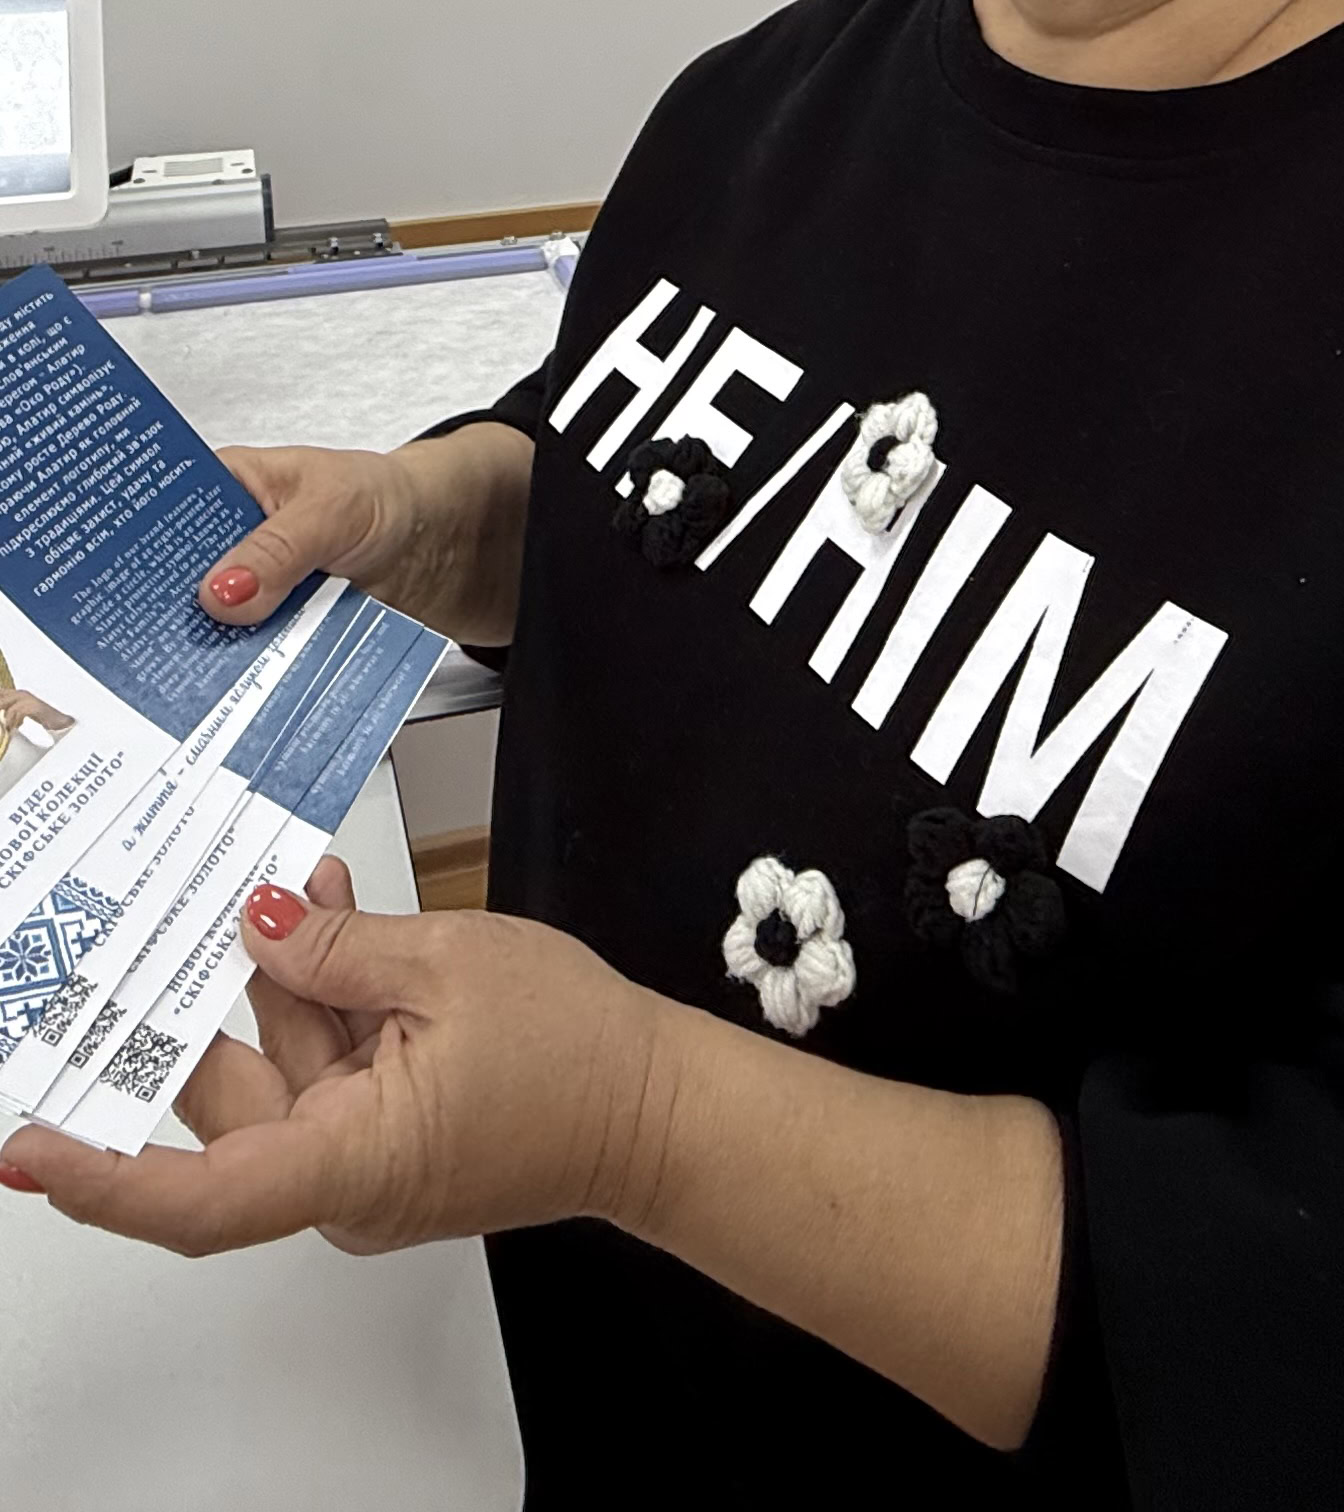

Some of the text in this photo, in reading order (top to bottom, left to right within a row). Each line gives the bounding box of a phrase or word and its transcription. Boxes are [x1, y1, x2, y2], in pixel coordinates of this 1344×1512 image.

[14, 293, 53, 320] містить
[18, 337, 46, 356] колі,
[47, 323, 62, 336] що
[15, 393, 44, 414] «Око
[43, 364, 84, 395] Роду»).
[47, 344, 85, 373] Алатир
[16, 403, 57, 435] Алатир
[58, 361, 115, 405] символізує
[24, 444, 57, 473] росте
[57, 413, 97, 448] Дерево
[96, 393, 123, 414] Роду.
[25, 416, 67, 448] «живий
[14, 428, 130, 522] елемент логотипу, ми
[37, 449, 77, 482] Алатир
[93, 397, 141, 439] головний
[0, 492, 76, 556] підкреслюємо
[77, 450, 126, 493] глибокий
[34, 460, 194, 596] гармонію всім, хто його носить.
[35, 496, 101, 548] традиціями.
[100, 474, 124, 494] Цей
[124, 443, 161, 476] символ
[45, 531, 82, 564] обіцяє
[81, 500, 122, 533] захист,
[121, 471, 152, 500] удачу
[72, 588, 91, 602] The
[9, 781, 54, 825] ВІДЕО
[36, 753, 103, 822] КОЛЕКЦІЇ
